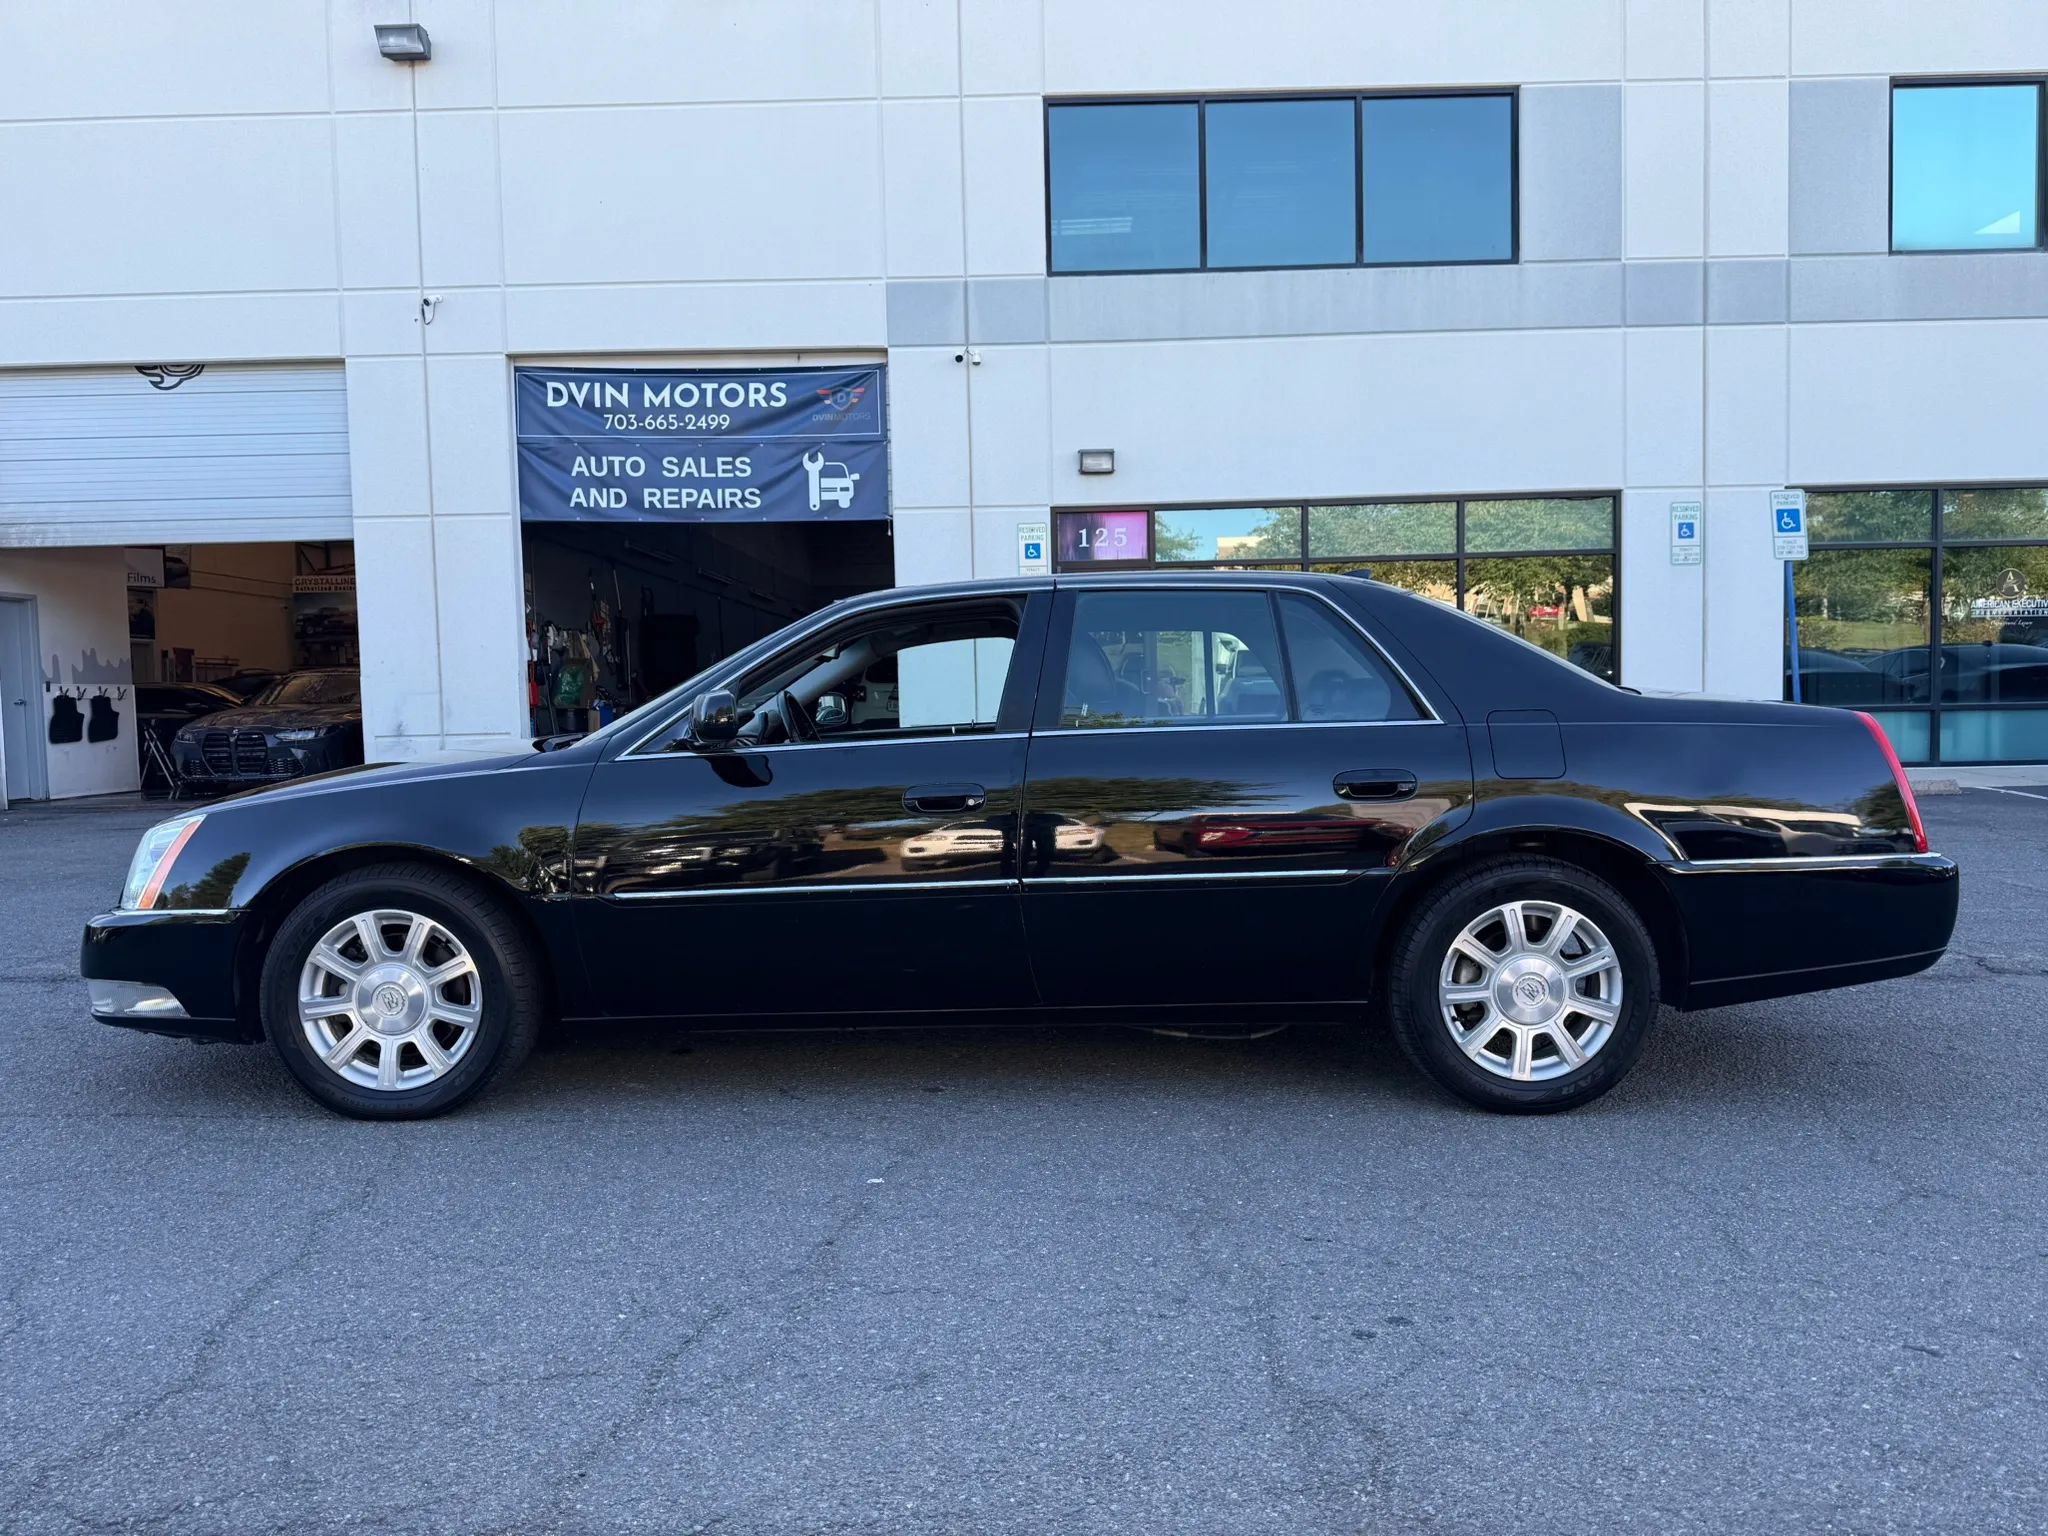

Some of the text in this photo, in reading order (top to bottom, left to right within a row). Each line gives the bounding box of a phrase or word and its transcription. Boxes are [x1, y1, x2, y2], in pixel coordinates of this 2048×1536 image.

[546, 381, 787, 408] DVIN MOTORS
[603, 413, 731, 430] 703-665-2499
[571, 456, 752, 478] AUTO SALES
[569, 487, 761, 509] AND REPAIRS
[1078, 527, 1128, 548] 125
[127, 571, 157, 584] Films
[294, 577, 355, 585] CRYSTALLINE
[1970, 599, 2010, 608] AMERICAN
